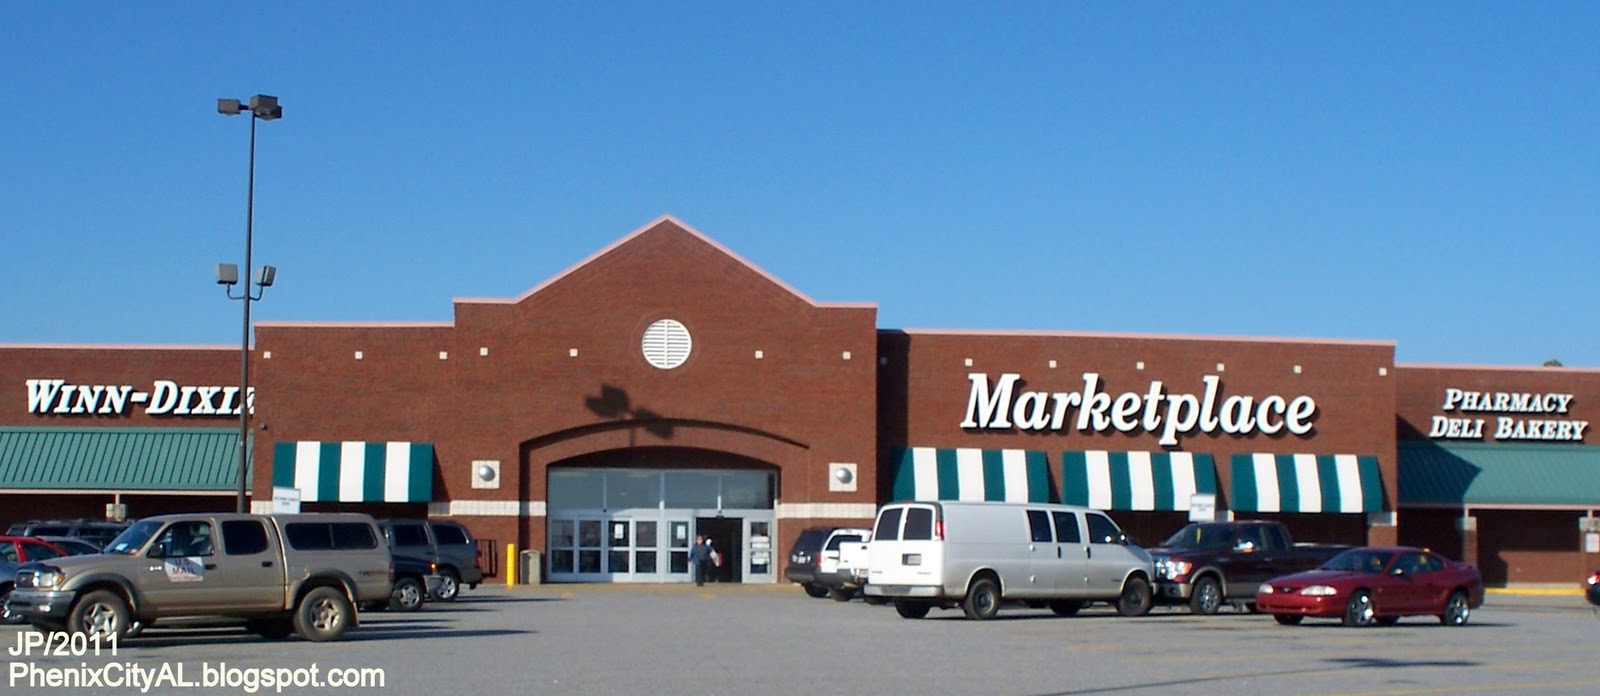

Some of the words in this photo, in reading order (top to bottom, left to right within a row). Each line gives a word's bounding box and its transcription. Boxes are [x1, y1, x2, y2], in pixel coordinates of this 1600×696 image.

[960, 373, 1316, 446] Marketplace
[1443, 388, 1573, 413] PHARMACY
[1429, 415, 1485, 438] DELI
[1494, 416, 1588, 441] BAKERY
[172, 566, 196, 575] MAIL
